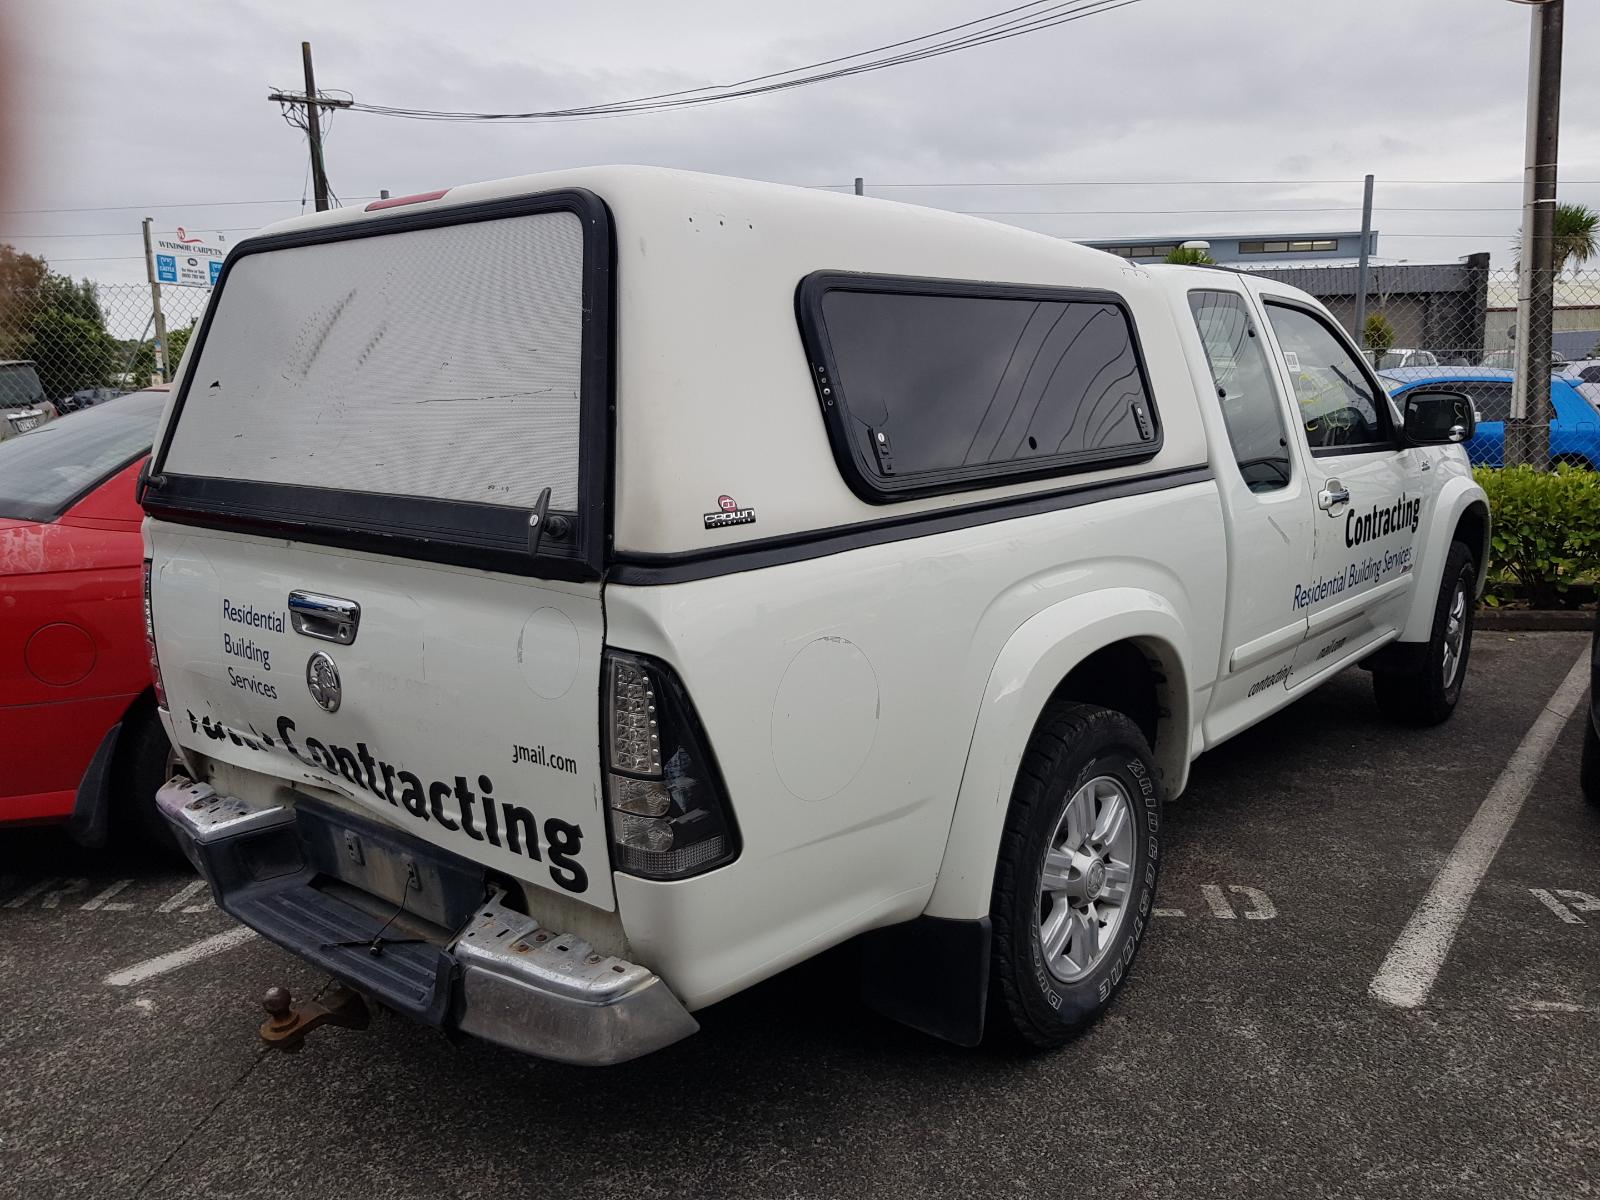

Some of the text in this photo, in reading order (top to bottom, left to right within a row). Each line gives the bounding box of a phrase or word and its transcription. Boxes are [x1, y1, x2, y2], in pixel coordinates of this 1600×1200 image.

[158, 240, 223, 256] WINDSOR CARPETS
[1345, 492, 1421, 548] Contracting
[1292, 545, 1413, 611] Residential Building Services
[223, 598, 286, 635] Residential
[224, 633, 272, 671] Building
[228, 667, 278, 700] Services
[276, 715, 589, 894] Contracting
